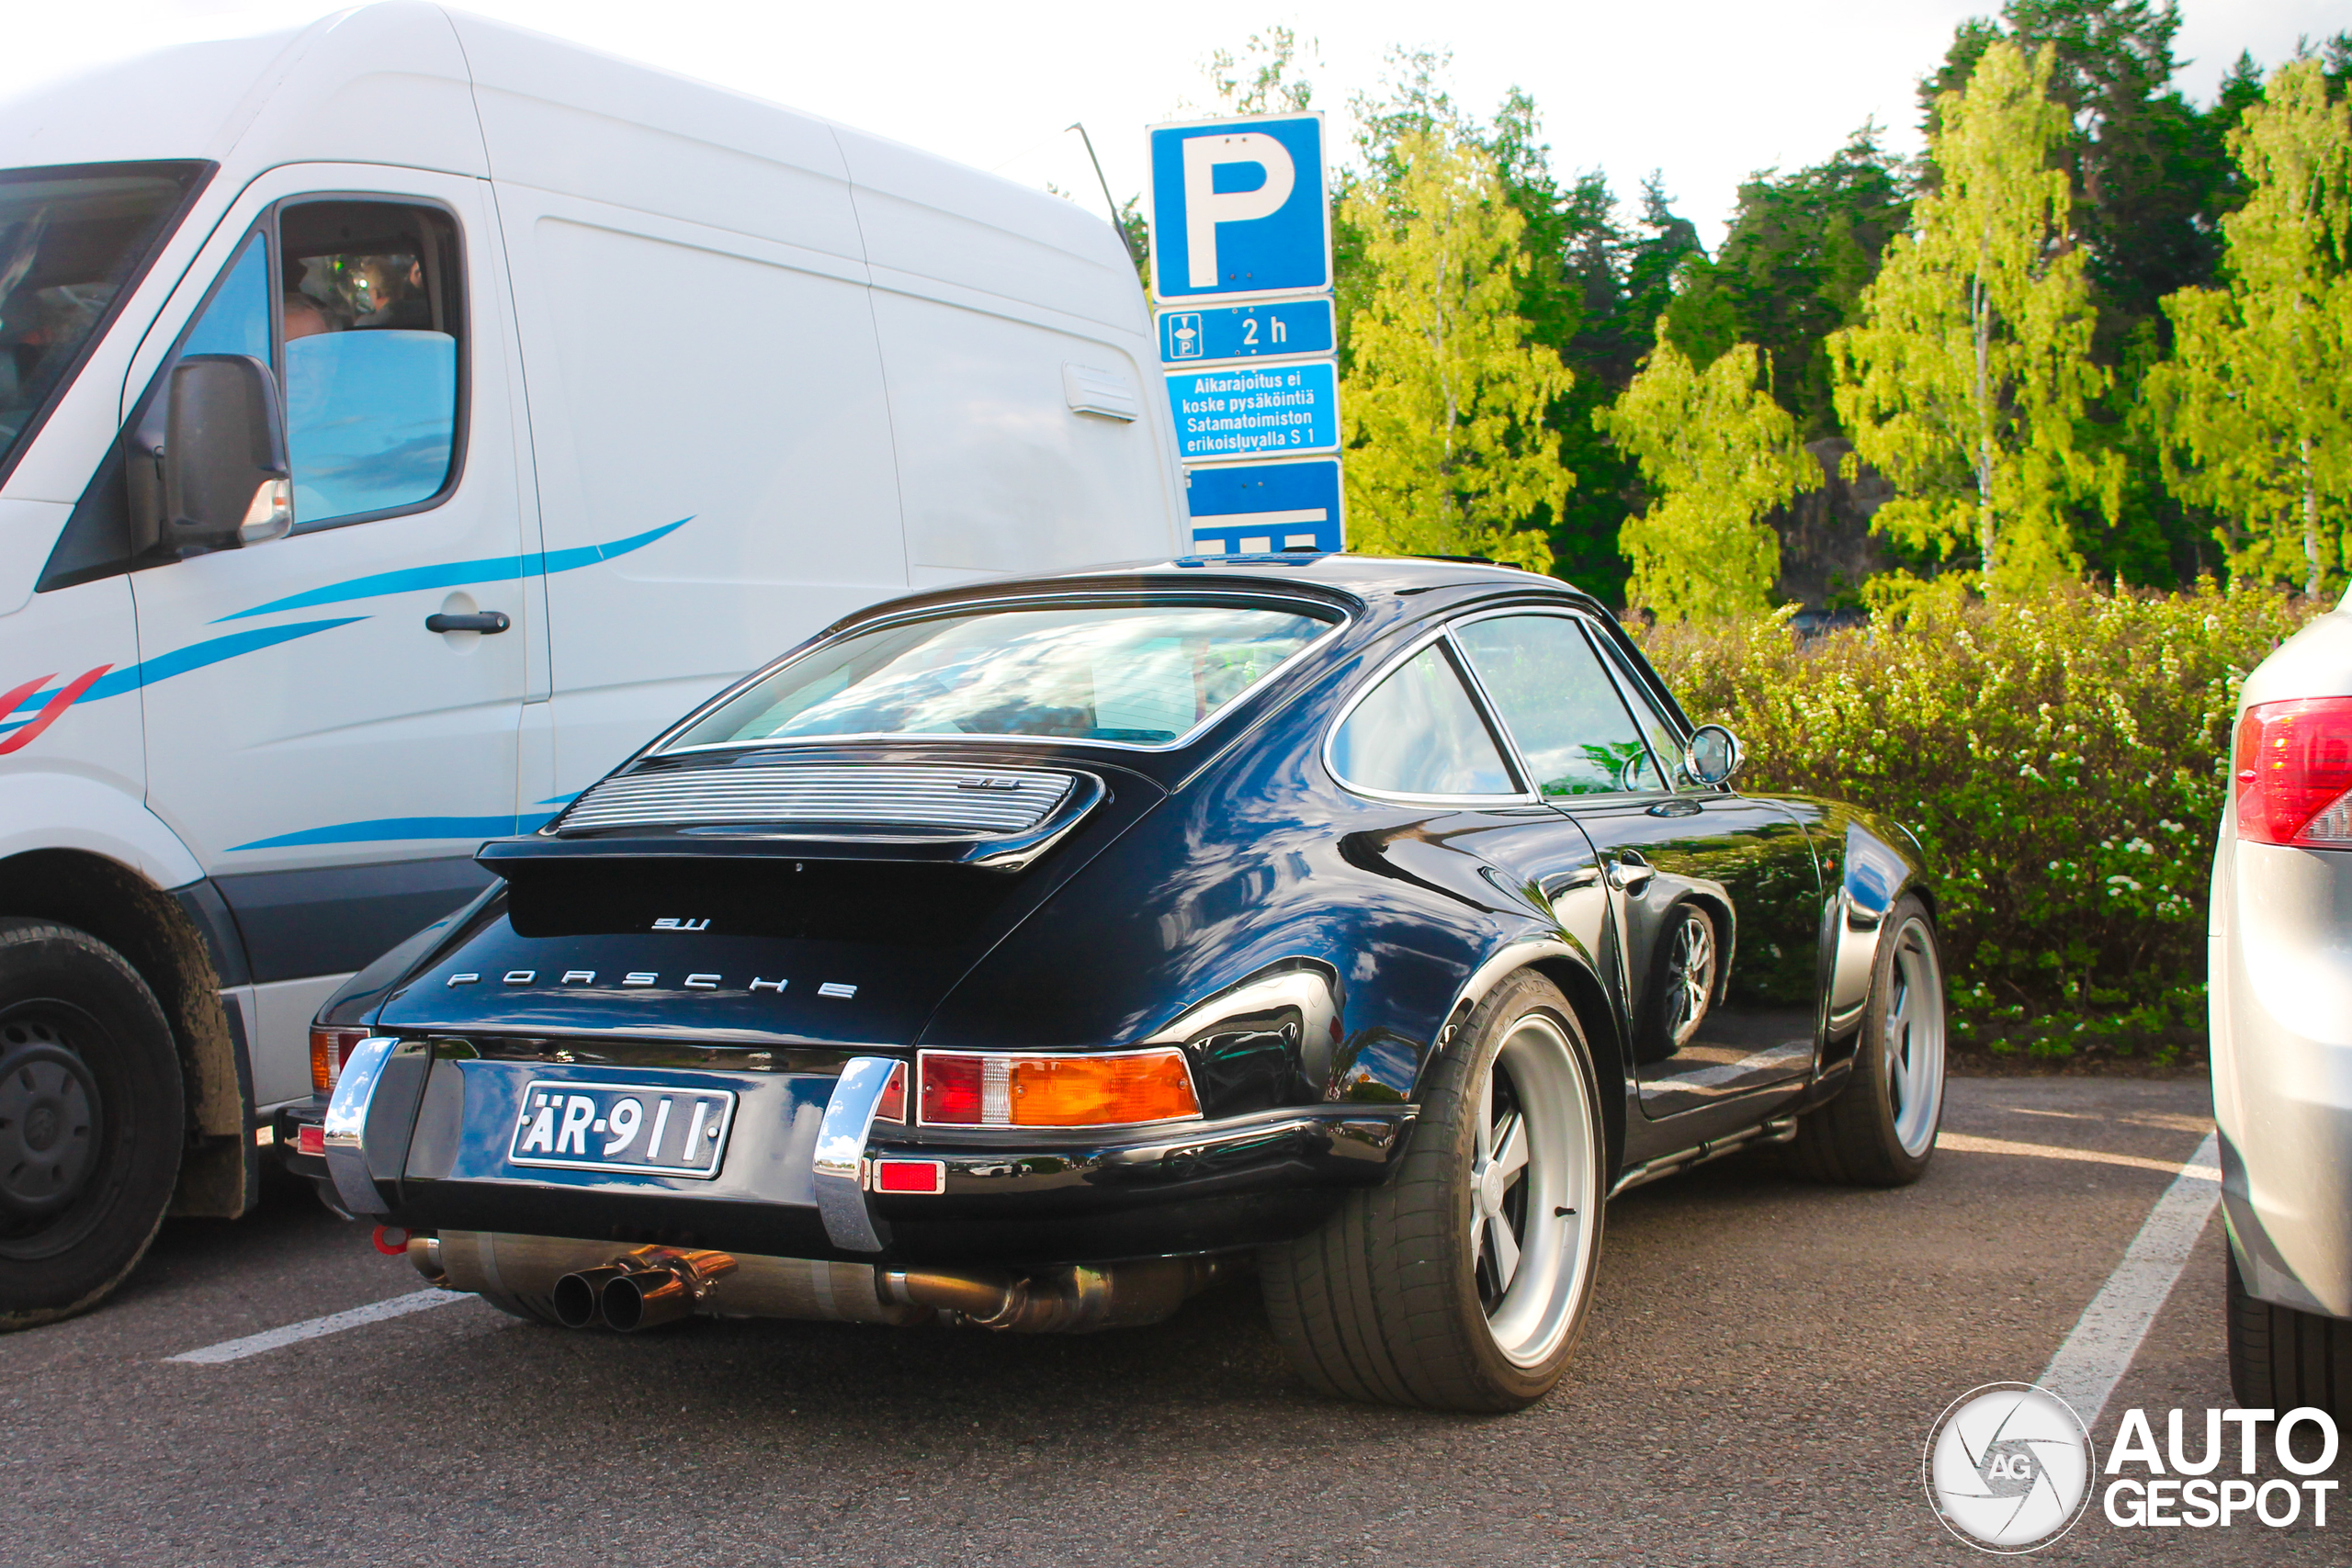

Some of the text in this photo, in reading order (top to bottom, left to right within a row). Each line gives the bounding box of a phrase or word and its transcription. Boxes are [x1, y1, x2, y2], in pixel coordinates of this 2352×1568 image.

[1182, 132, 1295, 288] P
[1242, 316, 1286, 344] 2 h
[1181, 341, 1192, 354] P
[1194, 371, 1301, 394] Aikarajoitus ei
[1182, 389, 1315, 413] koske pysäköintiä
[1187, 411, 1312, 433] Satamatoimiston
[1187, 428, 1314, 452] erikoisluvalla S 1
[651, 918, 710, 931] 911
[447, 970, 858, 999] PORSCHE
[521, 1093, 709, 1161] ÄR-911
